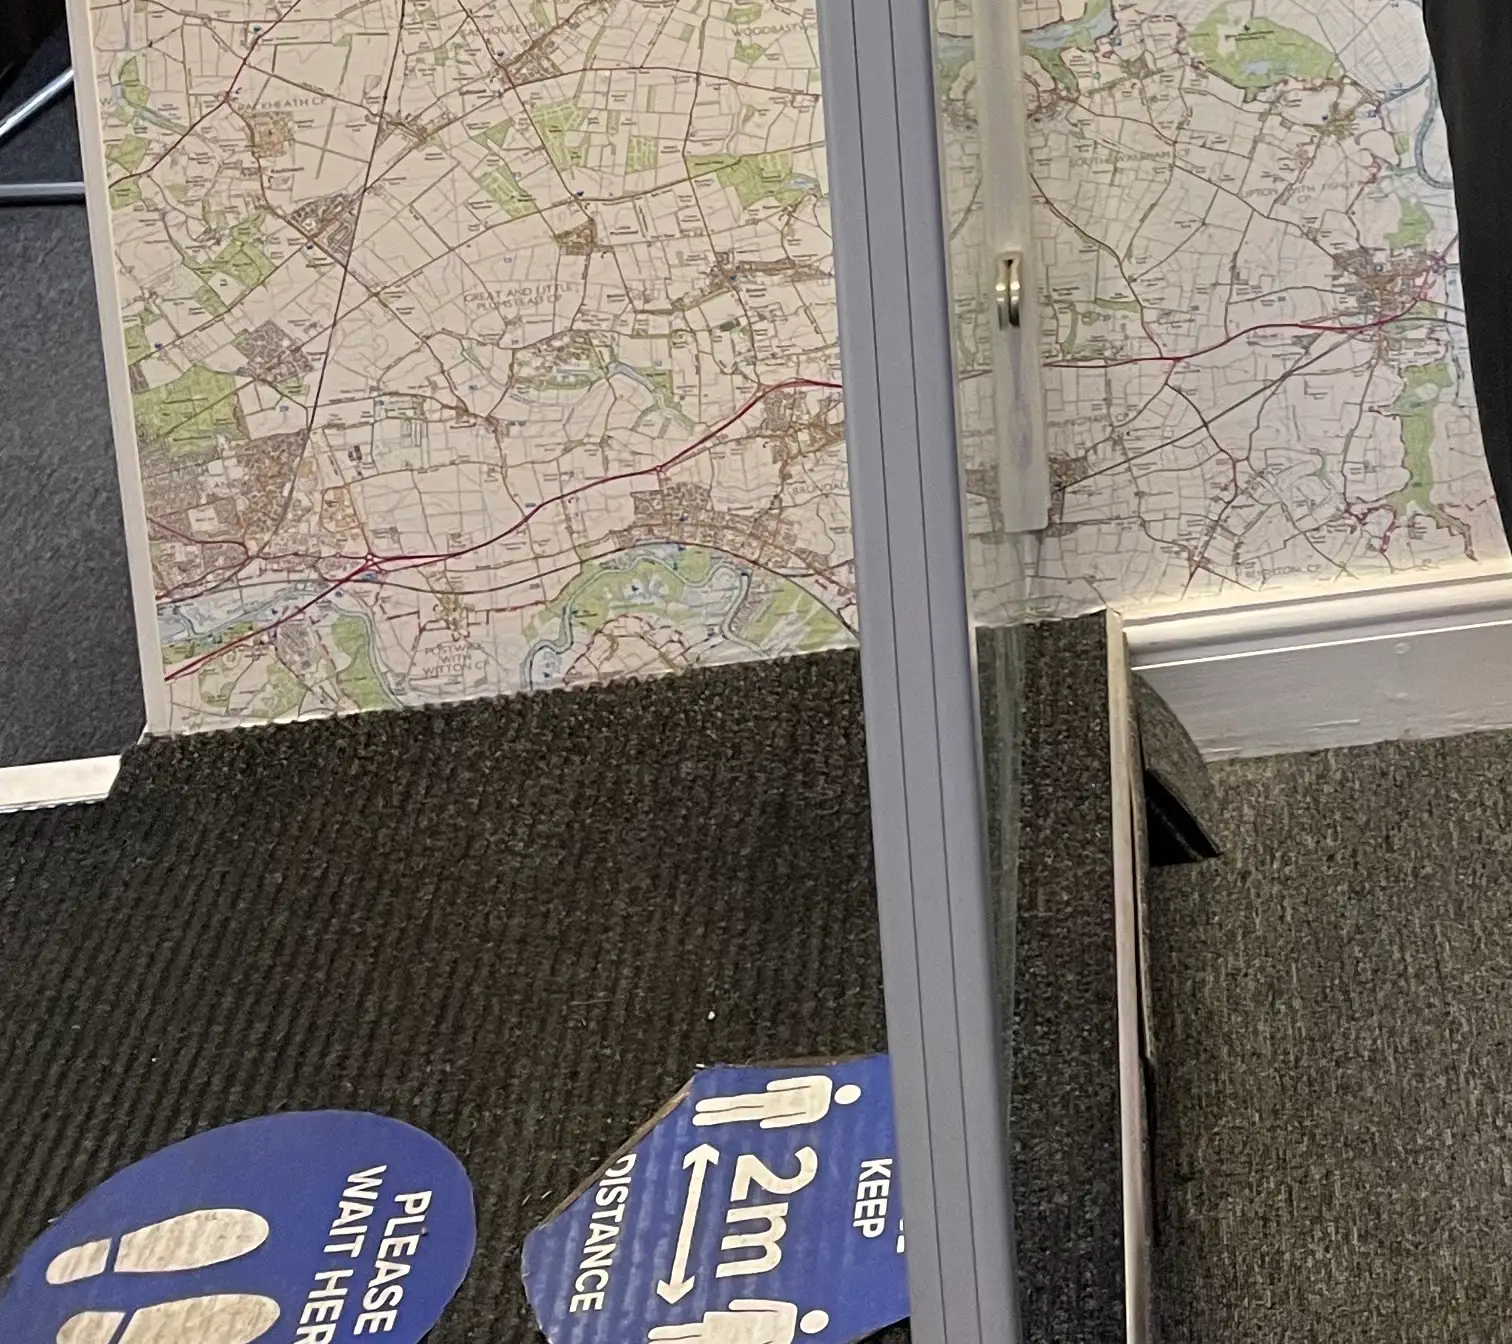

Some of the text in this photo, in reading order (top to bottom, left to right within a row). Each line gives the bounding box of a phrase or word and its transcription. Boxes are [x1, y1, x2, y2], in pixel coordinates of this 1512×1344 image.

[323, 1164, 388, 1259] WAIT
[353, 1189, 433, 1336] PLEASE
[568, 1152, 638, 1314] DISTANCE
[715, 1145, 819, 1280] 2m
[852, 1157, 894, 1239] KEEP
